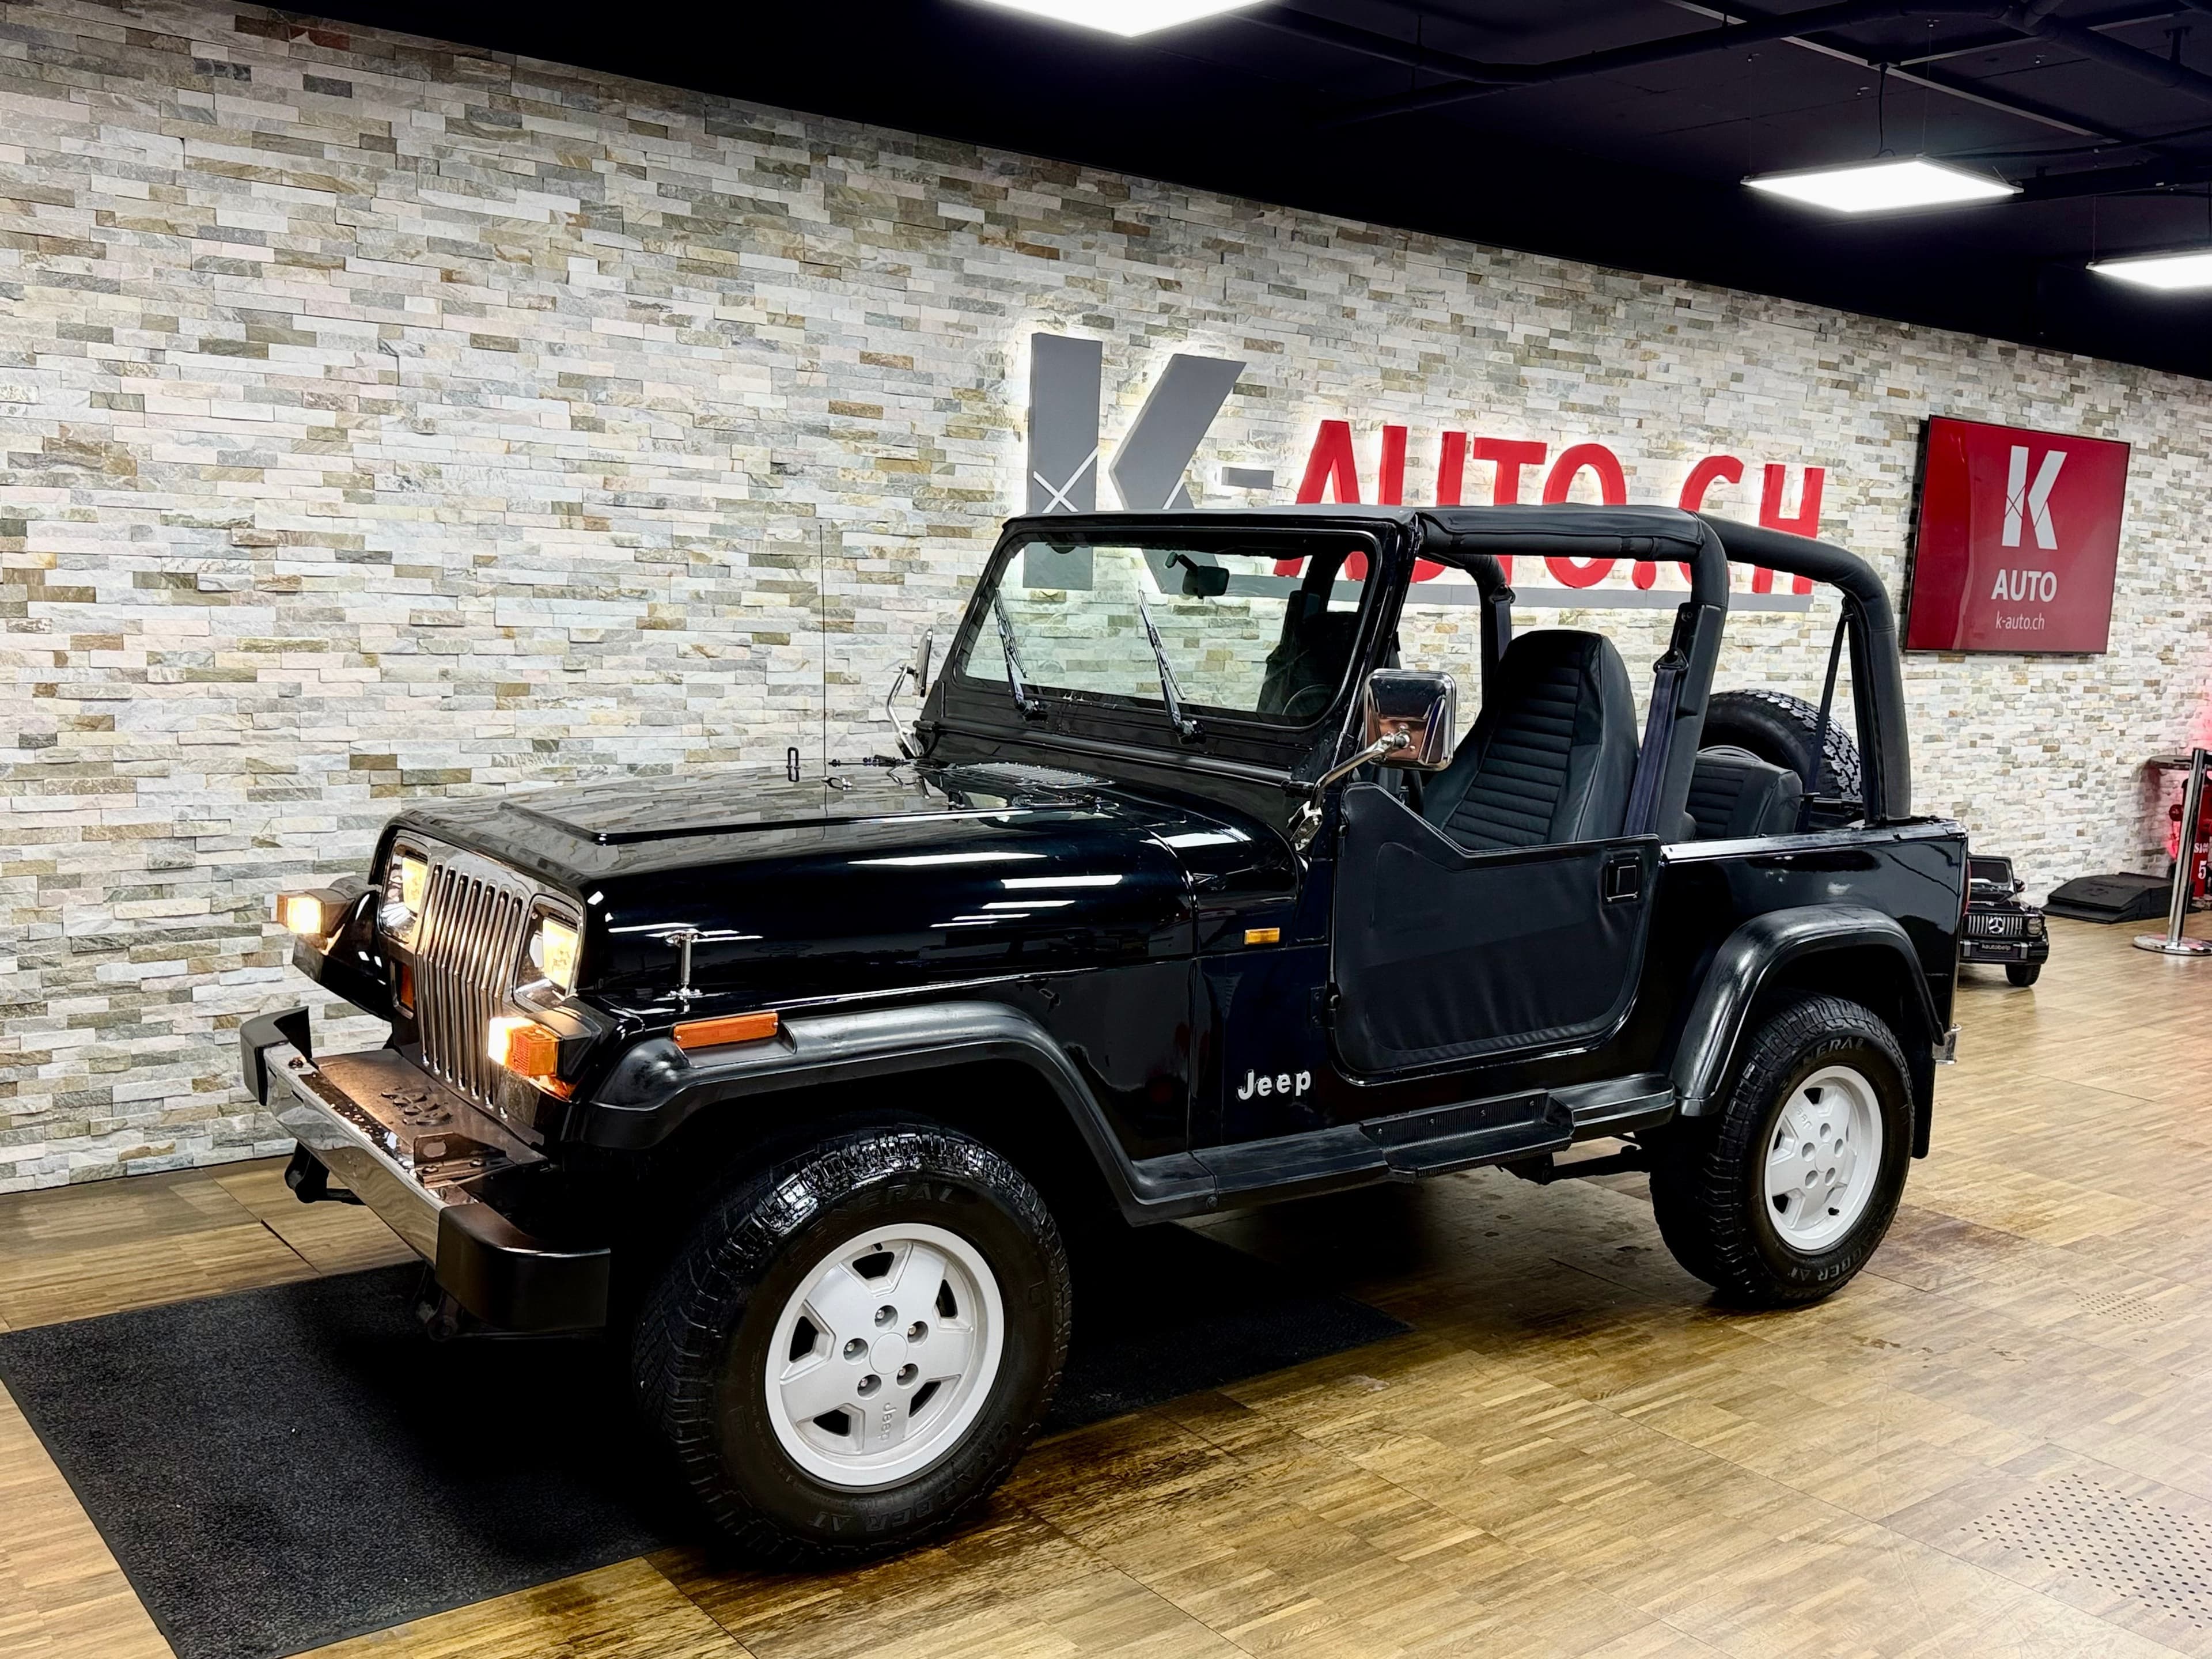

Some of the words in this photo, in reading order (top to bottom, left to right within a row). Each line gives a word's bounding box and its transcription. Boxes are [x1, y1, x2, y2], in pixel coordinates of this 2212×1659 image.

[2002, 445, 2067, 550] K
[1991, 569, 2058, 603] AUTO
[1995, 611, 2045, 630] k-auto.ch
[1237, 1069, 1312, 1101] Jeep
[877, 1402, 897, 1441] Jeep
